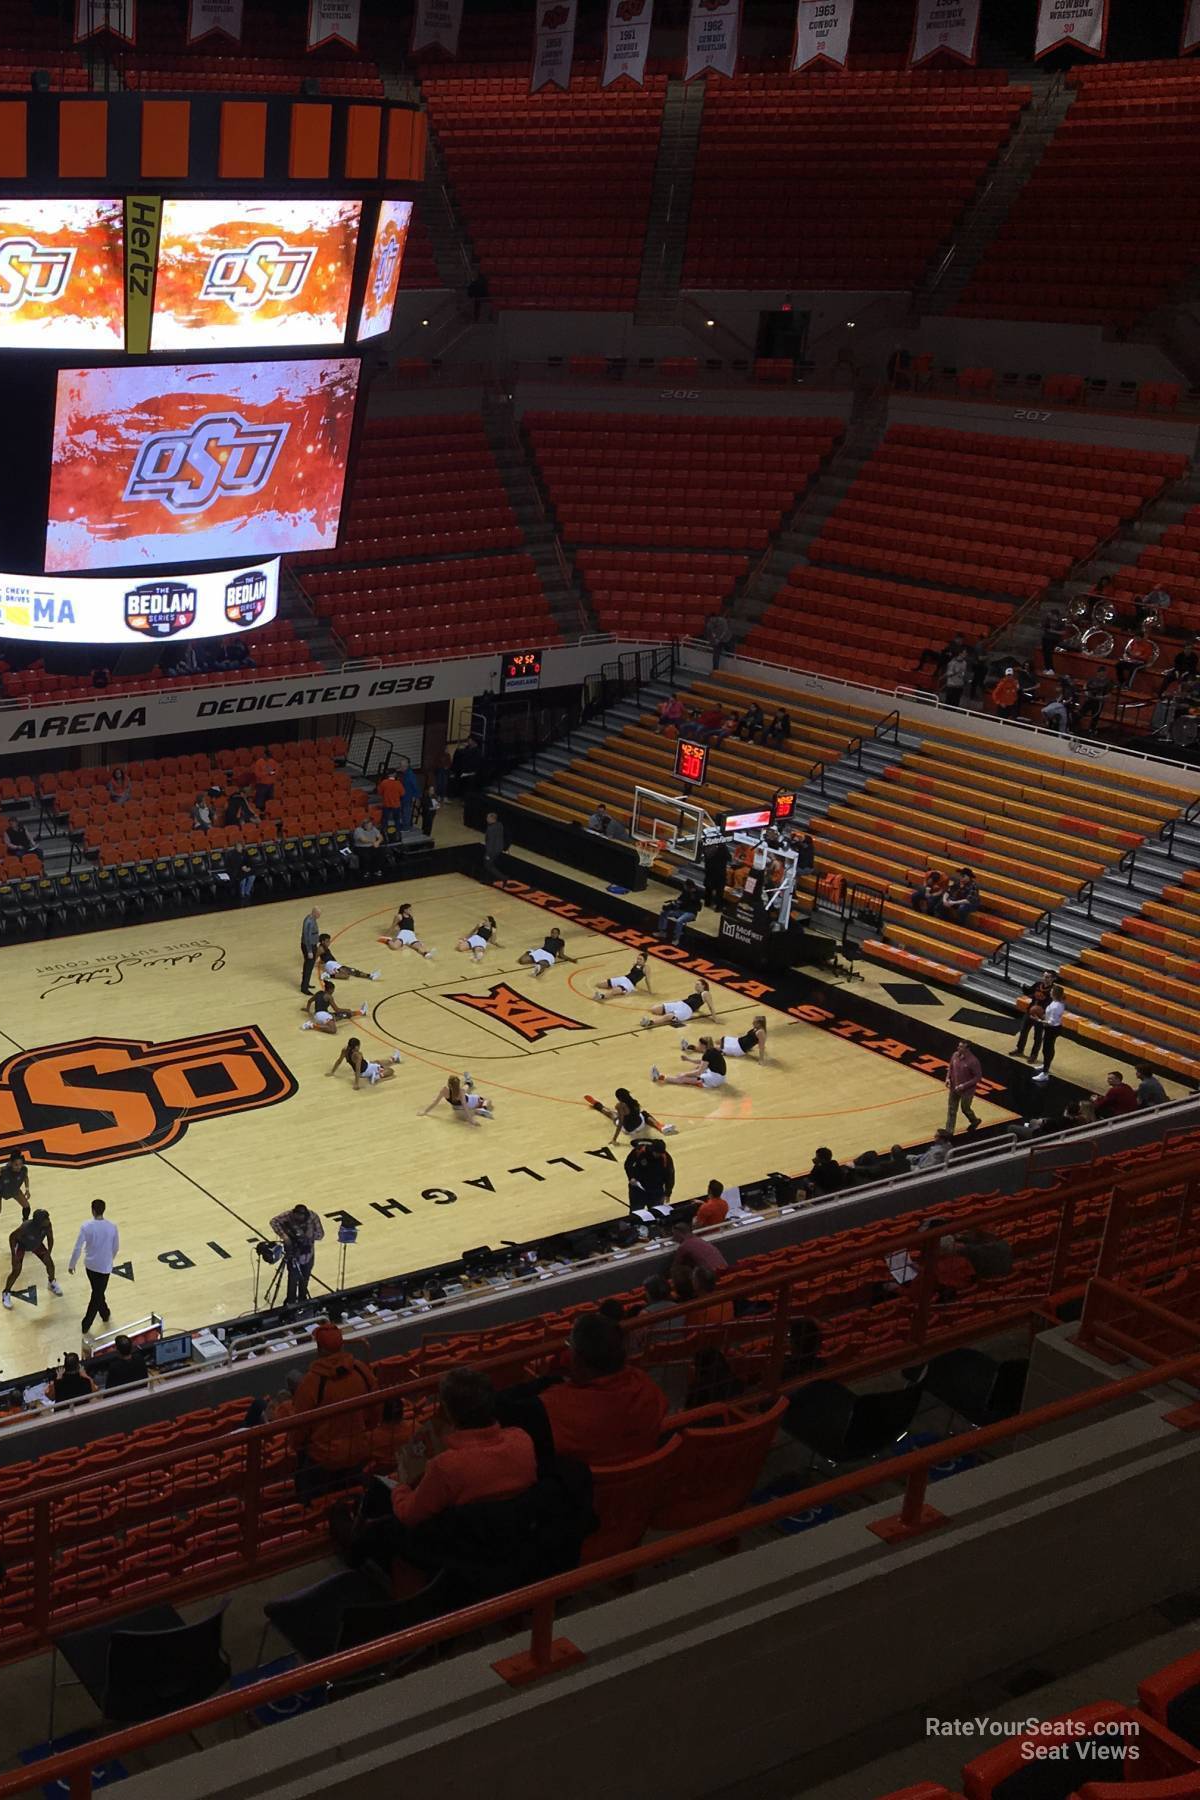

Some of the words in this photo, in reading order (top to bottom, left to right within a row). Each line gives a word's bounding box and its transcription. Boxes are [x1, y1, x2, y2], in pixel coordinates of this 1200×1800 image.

[814, 5, 836, 18] 1963
[1054, 0, 1090, 10] COWBOY
[1049, 8, 1094, 20] WRESTLING
[703, 20, 724, 32] 1962
[808, 18, 839, 30] COWBOY
[619, 29, 636, 41] 1961
[129, 202, 156, 297] Hertz
[199, 236, 318, 312] OSU
[660, 388, 702, 400] 206
[1013, 408, 1052, 422] 207
[123, 411, 292, 515] OSU
[5, 586, 31, 596] CHEVY
[227, 580, 266, 607] BEDLAM
[127, 592, 195, 615] BEDLAM
[148, 614, 176, 623] SERIES
[8, 706, 147, 742] ARENA
[196, 683, 360, 718] DEDICATED
[367, 675, 436, 697] 1938
[681, 743, 705, 760] 42:52
[492, 879, 776, 998] OKLAHOMA
[94, 947, 159, 963] SUTTON
[36, 960, 90, 974] COURT
